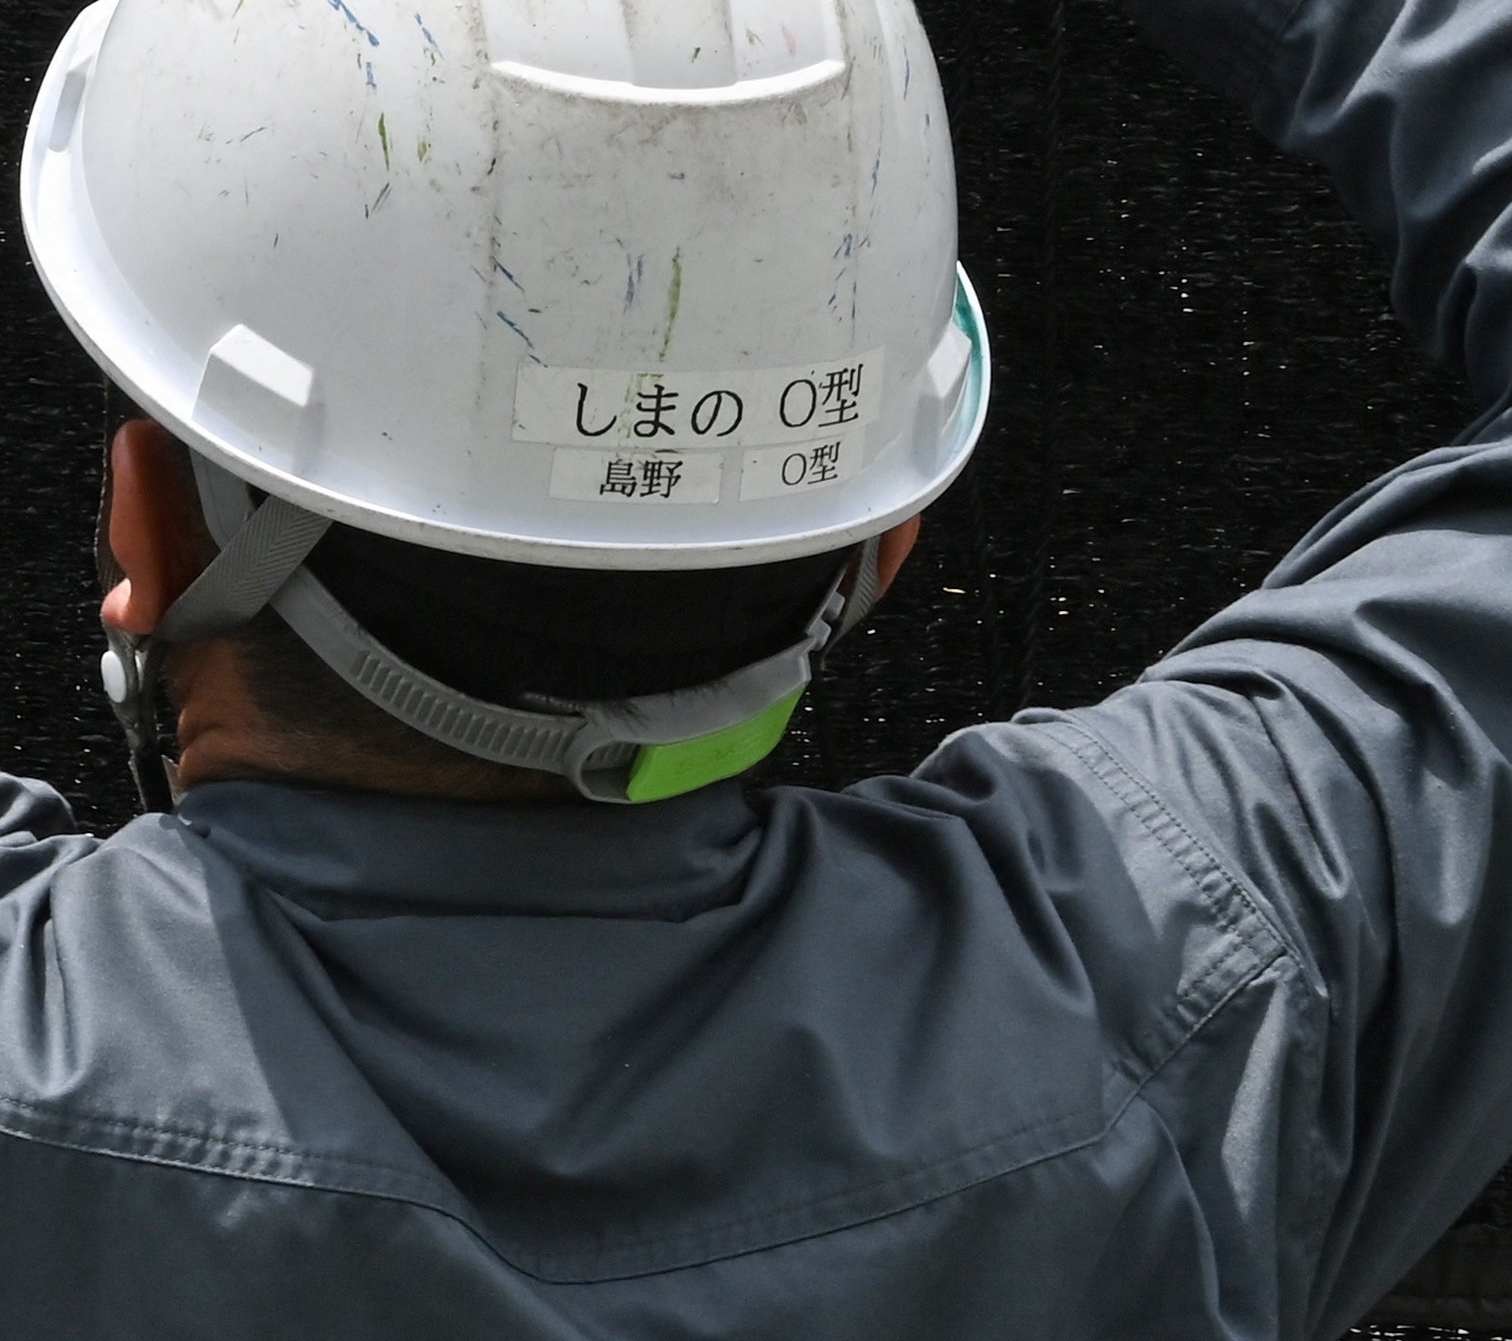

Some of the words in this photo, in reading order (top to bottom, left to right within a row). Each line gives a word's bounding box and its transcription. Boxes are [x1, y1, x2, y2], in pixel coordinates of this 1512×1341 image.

[574, 382, 744, 438] しまの
[598, 457, 684, 500] 島野
